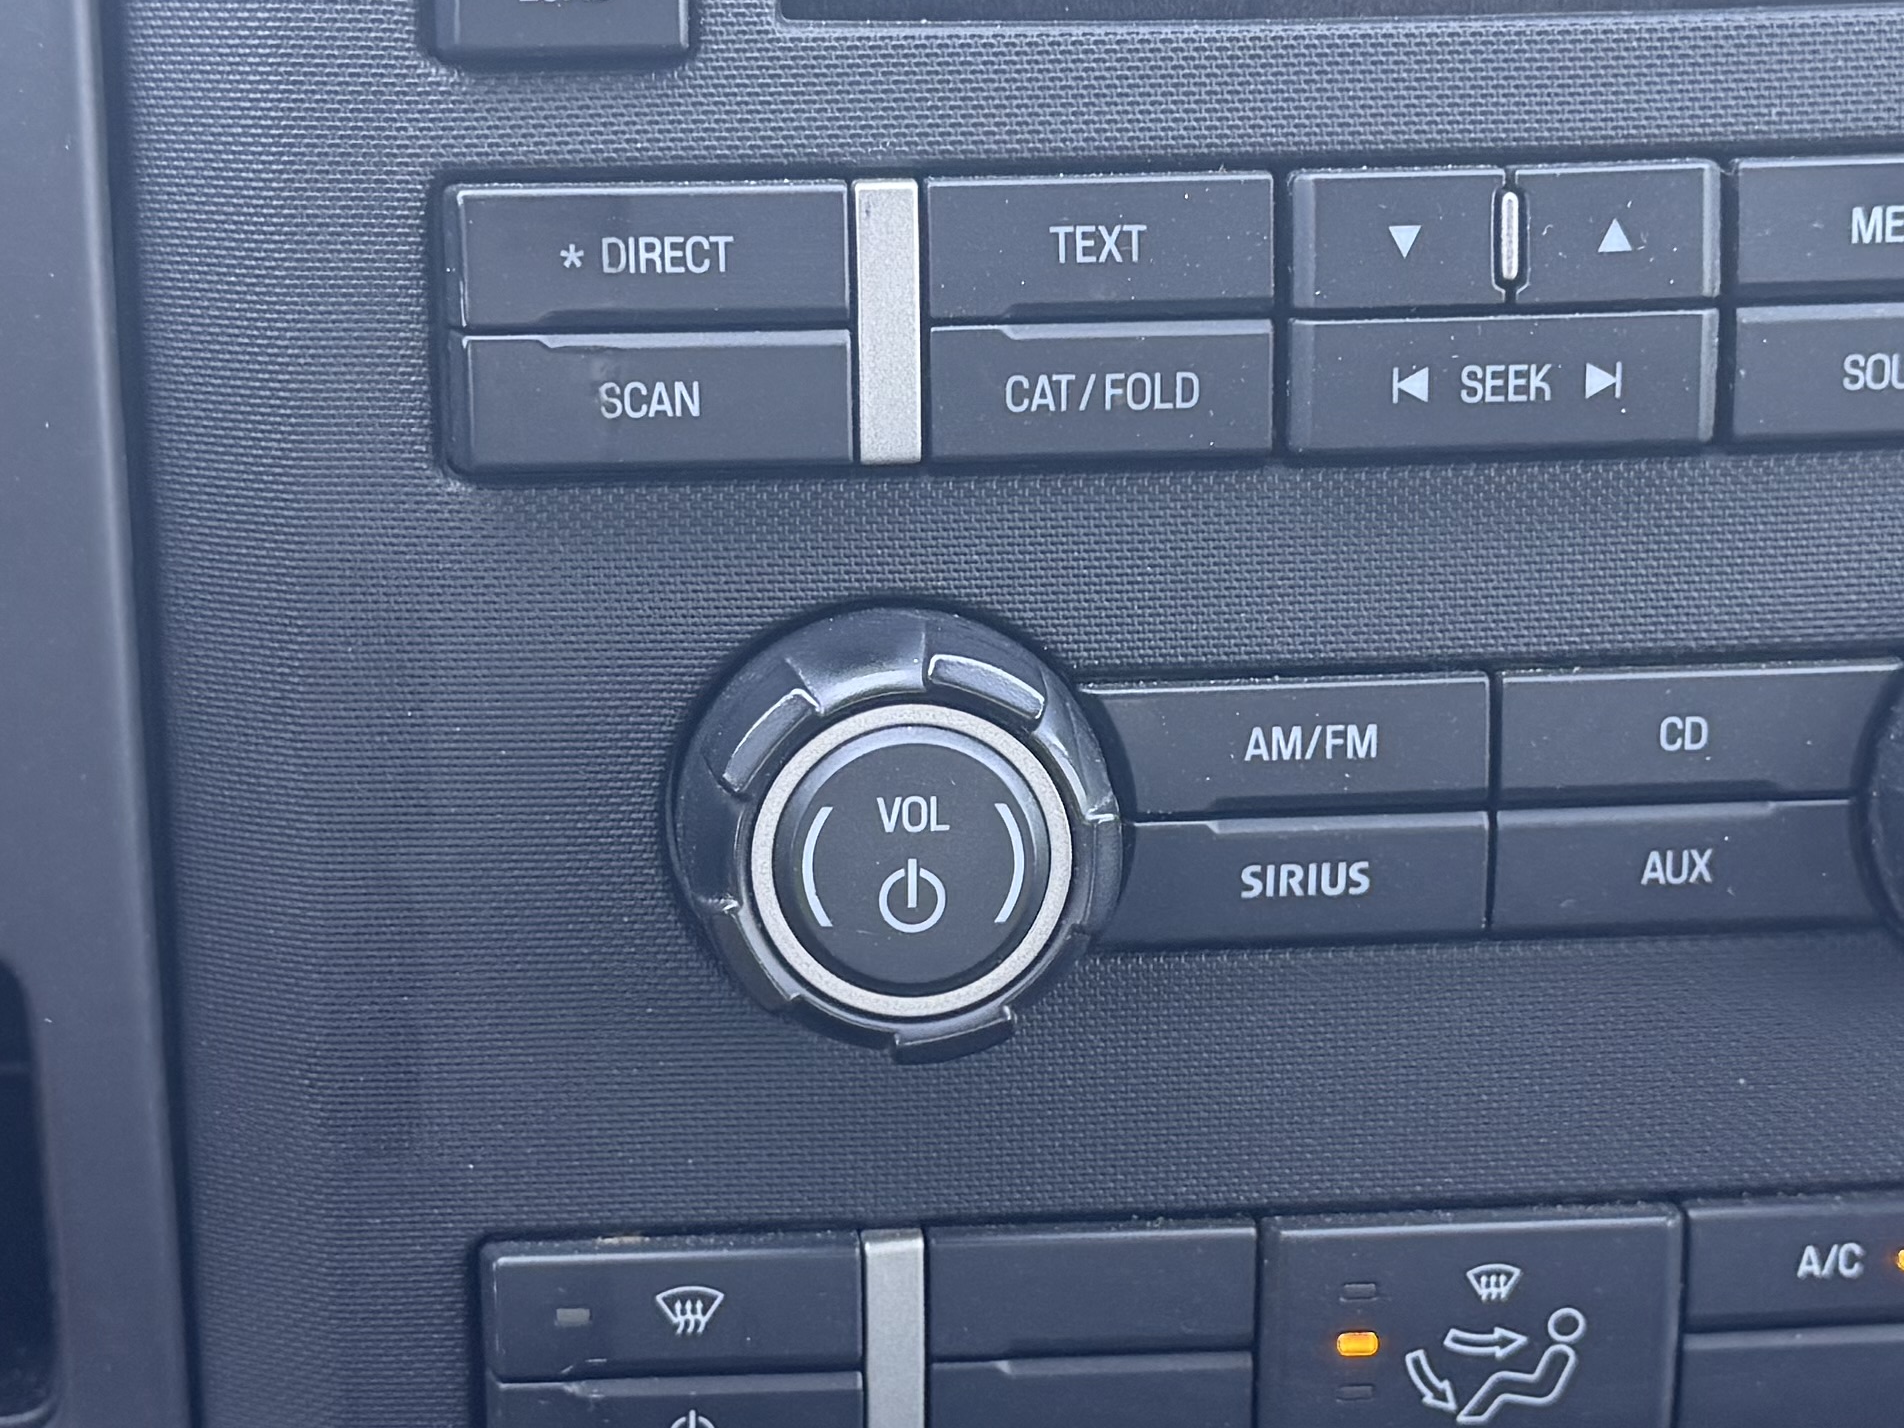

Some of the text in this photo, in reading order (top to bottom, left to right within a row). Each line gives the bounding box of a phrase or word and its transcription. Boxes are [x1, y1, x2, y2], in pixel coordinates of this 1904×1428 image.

[601, 235, 735, 274] DIRECT
[1048, 224, 1148, 264] TEXT
[598, 380, 700, 419] SCAN
[1460, 363, 1552, 404] SEEK
[1244, 723, 1379, 762] AM/FM
[1659, 715, 1709, 752] CD
[876, 795, 951, 833] VOL
[1240, 861, 1371, 899] SIRIUS
[1640, 848, 1714, 886] AUX
[1796, 1242, 1865, 1278] A/C
